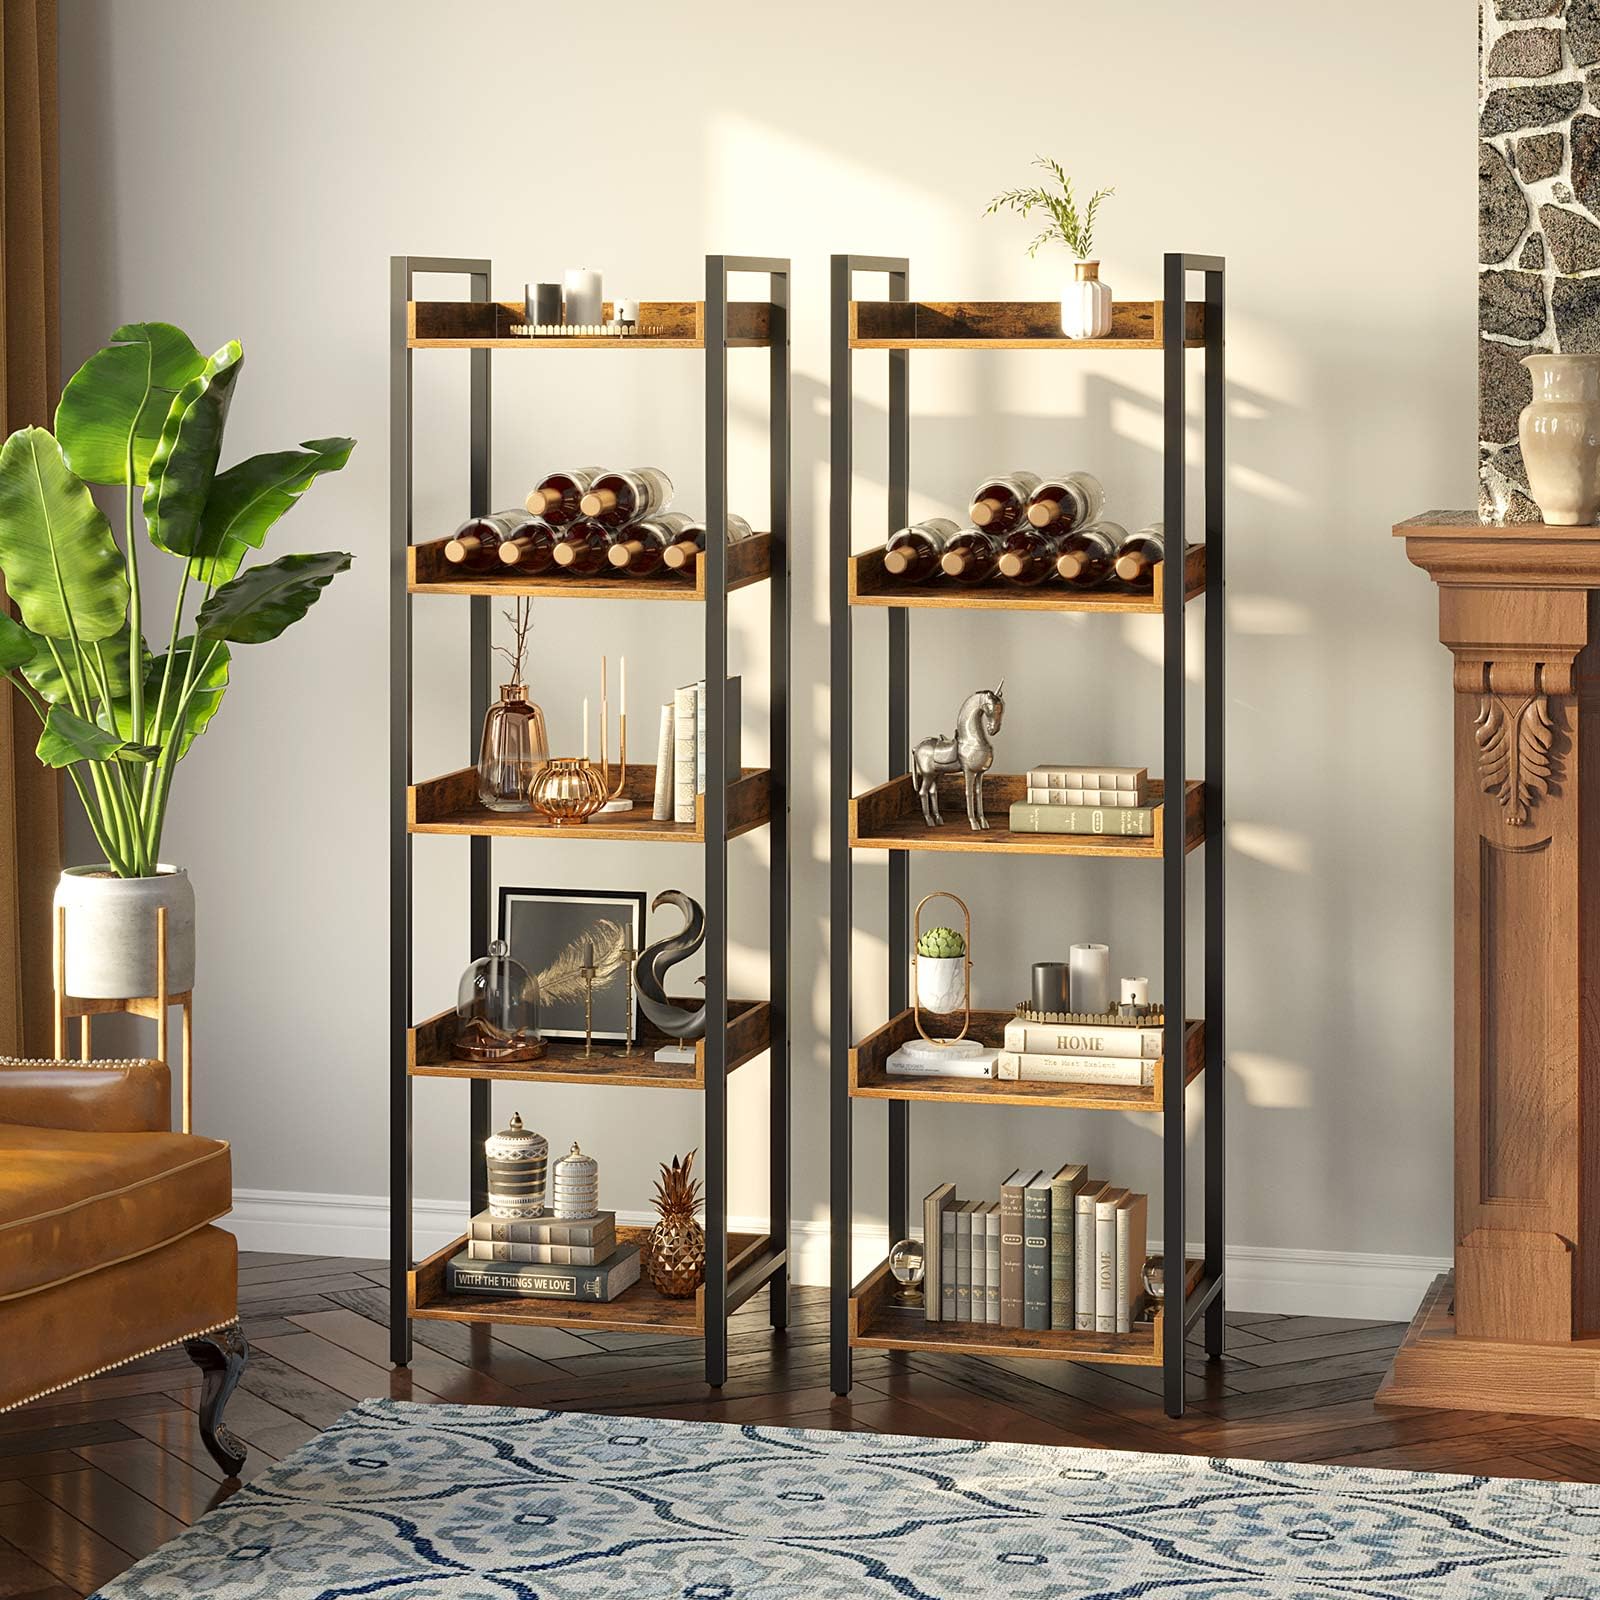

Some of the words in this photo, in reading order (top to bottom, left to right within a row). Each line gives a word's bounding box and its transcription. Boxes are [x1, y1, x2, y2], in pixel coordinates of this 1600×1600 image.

[1056, 1035, 1105, 1051] HOME
[1100, 1251, 1112, 1290] HOME
[458, 1273, 481, 1285] WITH
[482, 1275, 499, 1286] THE
[500, 1276, 533, 1289] THINGS
[534, 1278, 548, 1290] WE
[549, 1279, 571, 1291] LOVE
